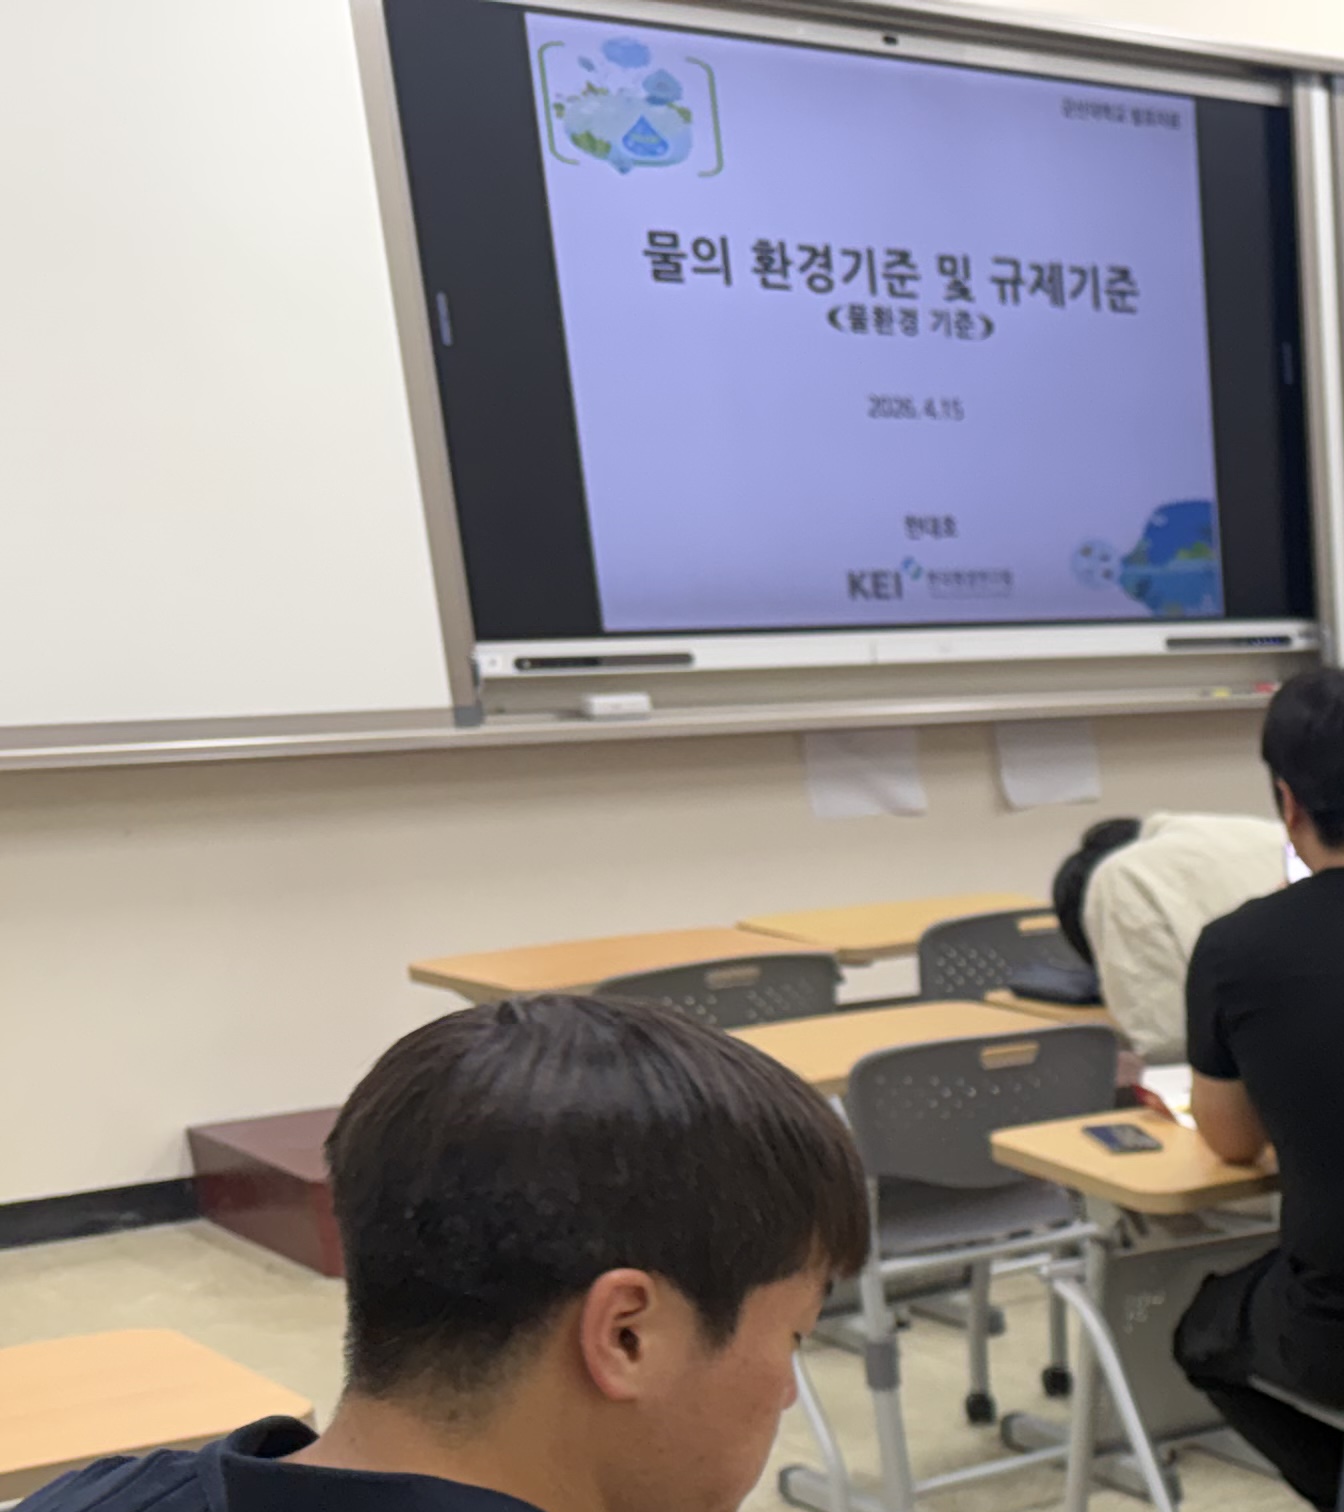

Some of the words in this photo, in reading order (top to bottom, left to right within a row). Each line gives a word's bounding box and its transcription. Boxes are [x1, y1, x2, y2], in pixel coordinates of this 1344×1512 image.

[643, 229, 733, 287] 물의
[750, 238, 921, 299] 환경기준
[936, 253, 977, 302] 및
[990, 255, 1140, 314] 규제기준
[847, 568, 904, 600] KEI
